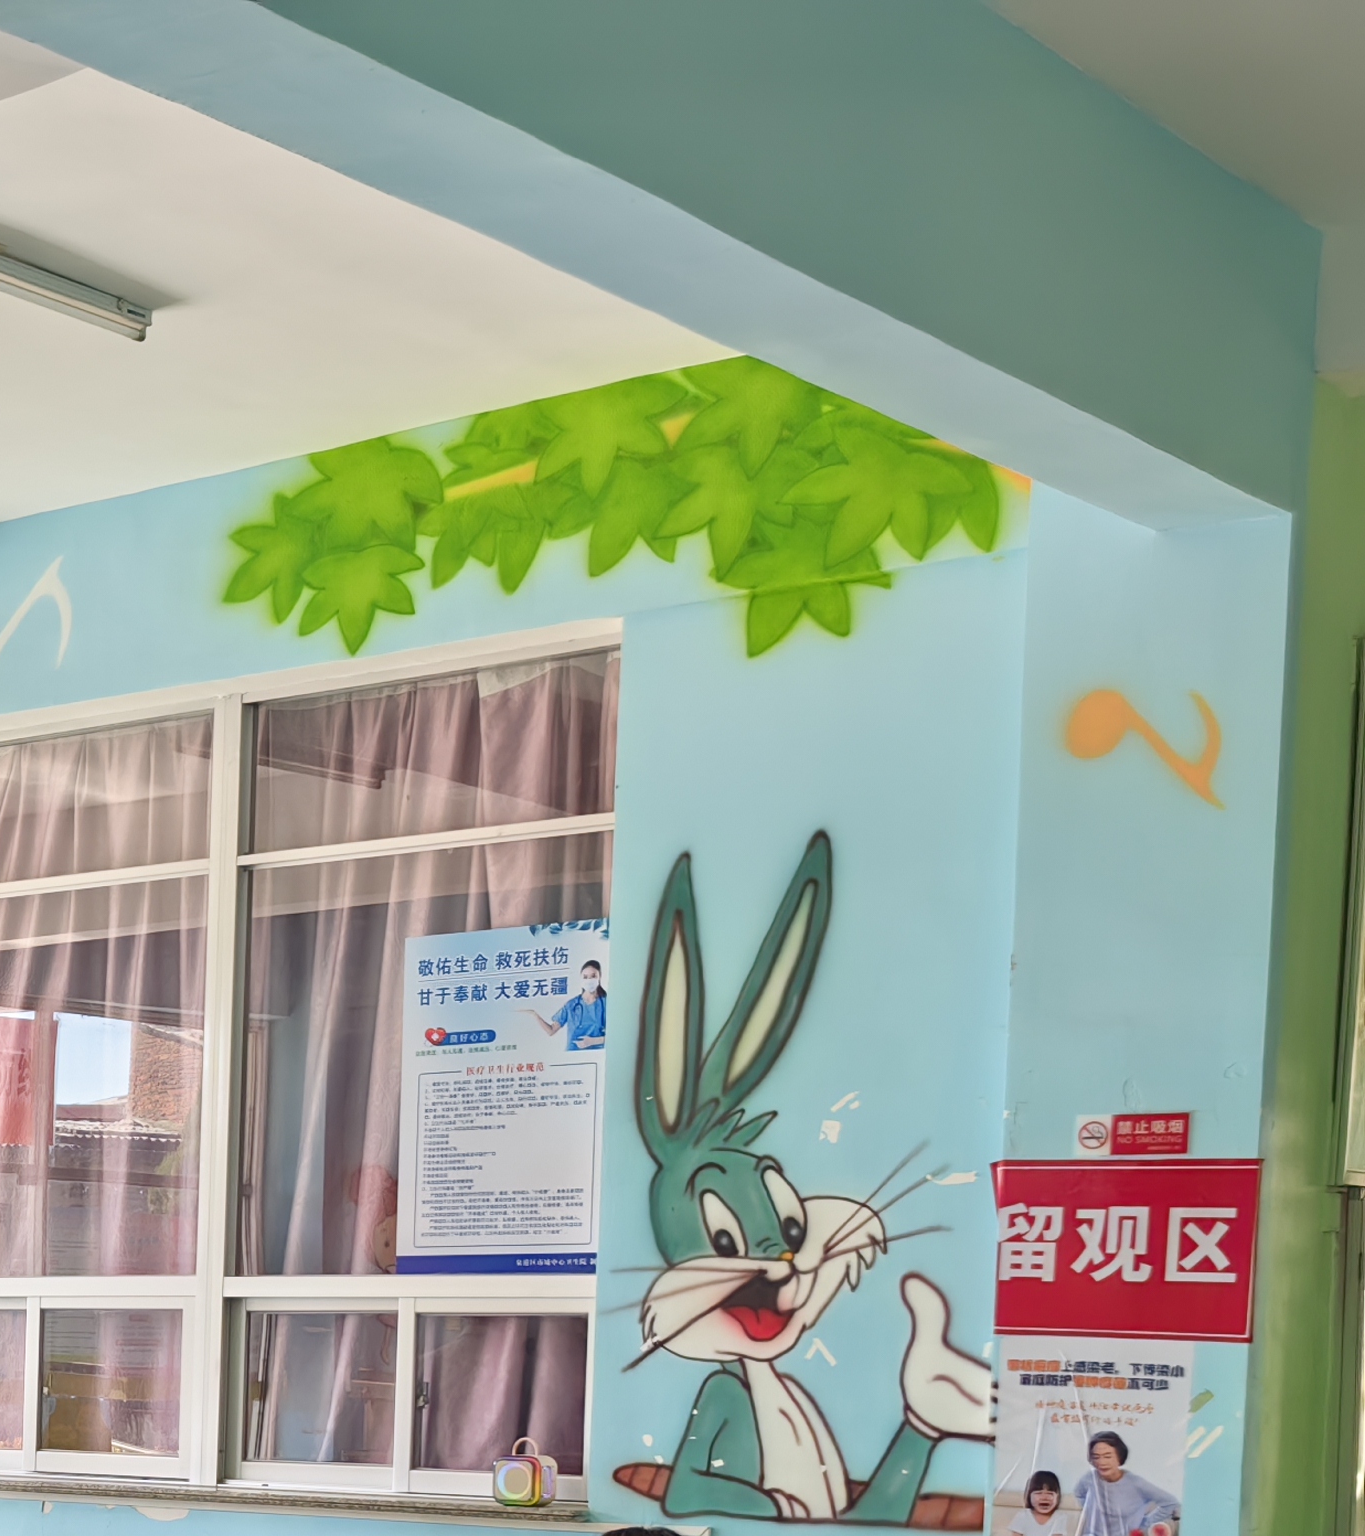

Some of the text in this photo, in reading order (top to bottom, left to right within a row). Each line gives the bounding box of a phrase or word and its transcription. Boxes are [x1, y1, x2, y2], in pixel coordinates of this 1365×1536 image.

[418, 946, 569, 978] 敬佑生命 救死扶伤
[418, 976, 569, 1006] 甘于奉献 大爱无疆
[466, 1062, 545, 1077] 医疗卫生行业规范
[1116, 1119, 1185, 1136] 禁止吸烟
[1117, 1134, 1183, 1144] NO SMOKING
[998, 1202, 1238, 1283] 留观区
